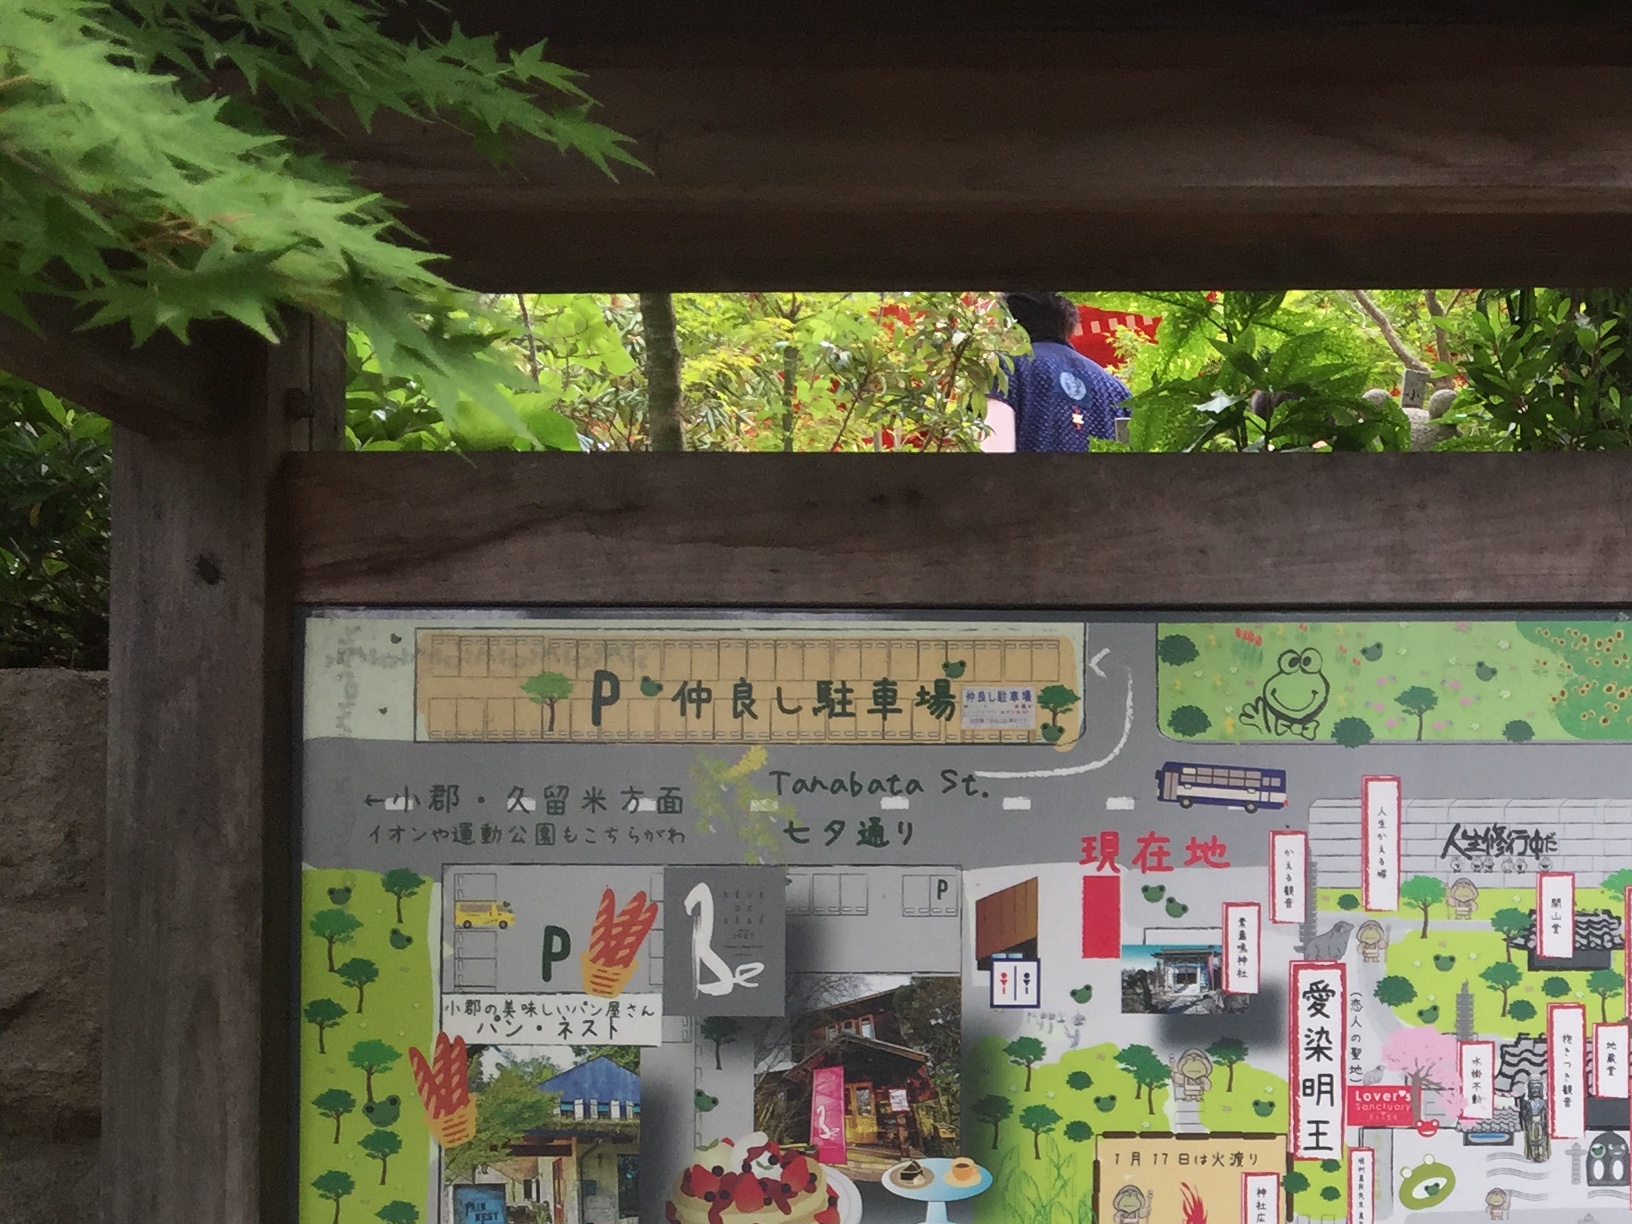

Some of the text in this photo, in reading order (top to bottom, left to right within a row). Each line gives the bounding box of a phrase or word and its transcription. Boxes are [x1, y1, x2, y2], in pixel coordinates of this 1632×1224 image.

[589, 667, 621, 727] P
[670, 679, 956, 721] 仲良し駐車場
[380, 780, 686, 818] 小郡・久留米方面
[768, 768, 990, 799] Tanabata St.
[366, 821, 686, 847] イオンや運動公園もこちらがわ
[782, 815, 913, 849] 七夕通り
[1078, 830, 1232, 875] 現在地
[936, 878, 949, 901] P
[541, 924, 572, 983] P
[474, 1012, 620, 1042] パン・ネスト
[1301, 979, 1337, 1152] 愛染明王
[1114, 1150, 1258, 1168] 1月17日は火渡り
